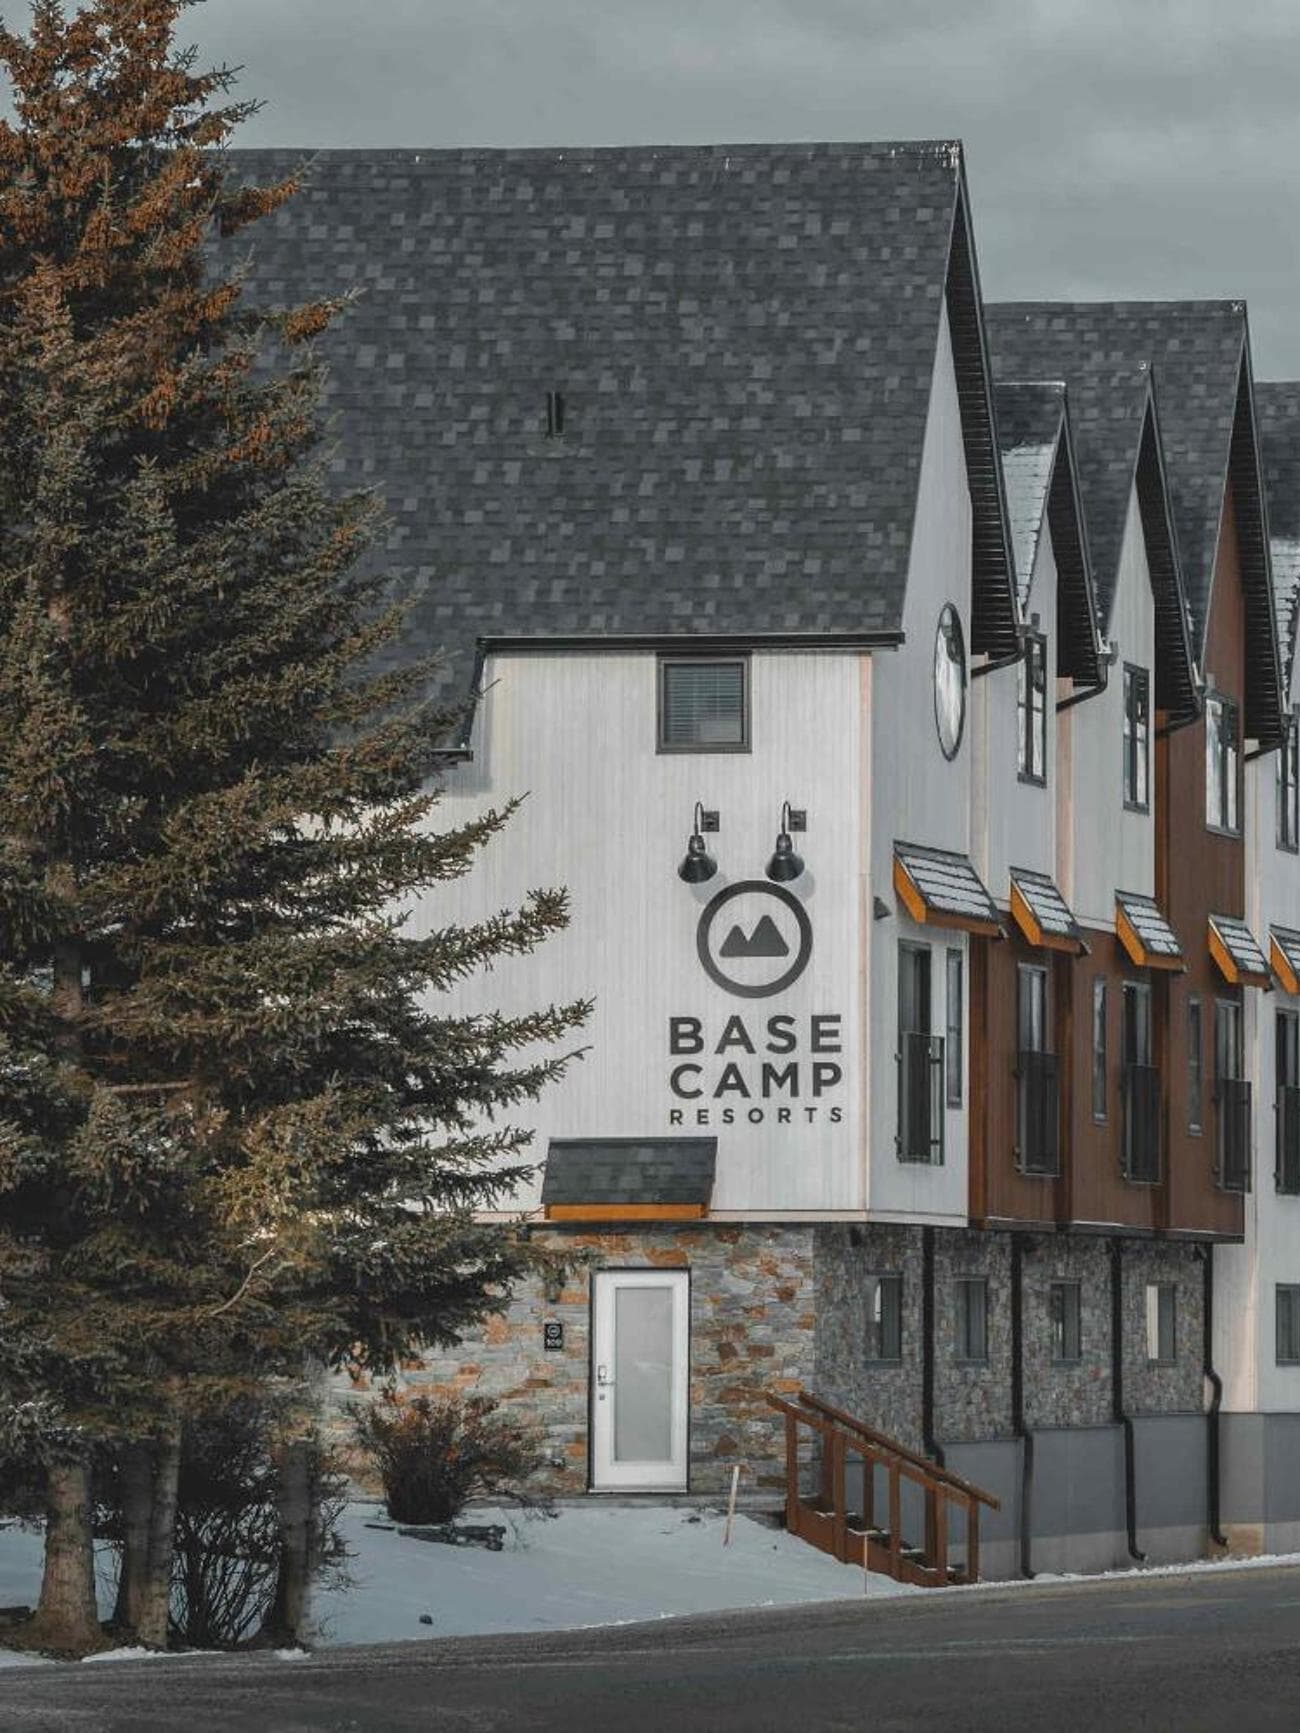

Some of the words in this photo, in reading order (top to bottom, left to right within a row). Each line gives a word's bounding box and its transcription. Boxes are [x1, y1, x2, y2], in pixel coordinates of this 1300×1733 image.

[669, 1014, 842, 1055] BASE
[669, 1062, 842, 1099] CAMP
[669, 1107, 842, 1125] RESORTS
